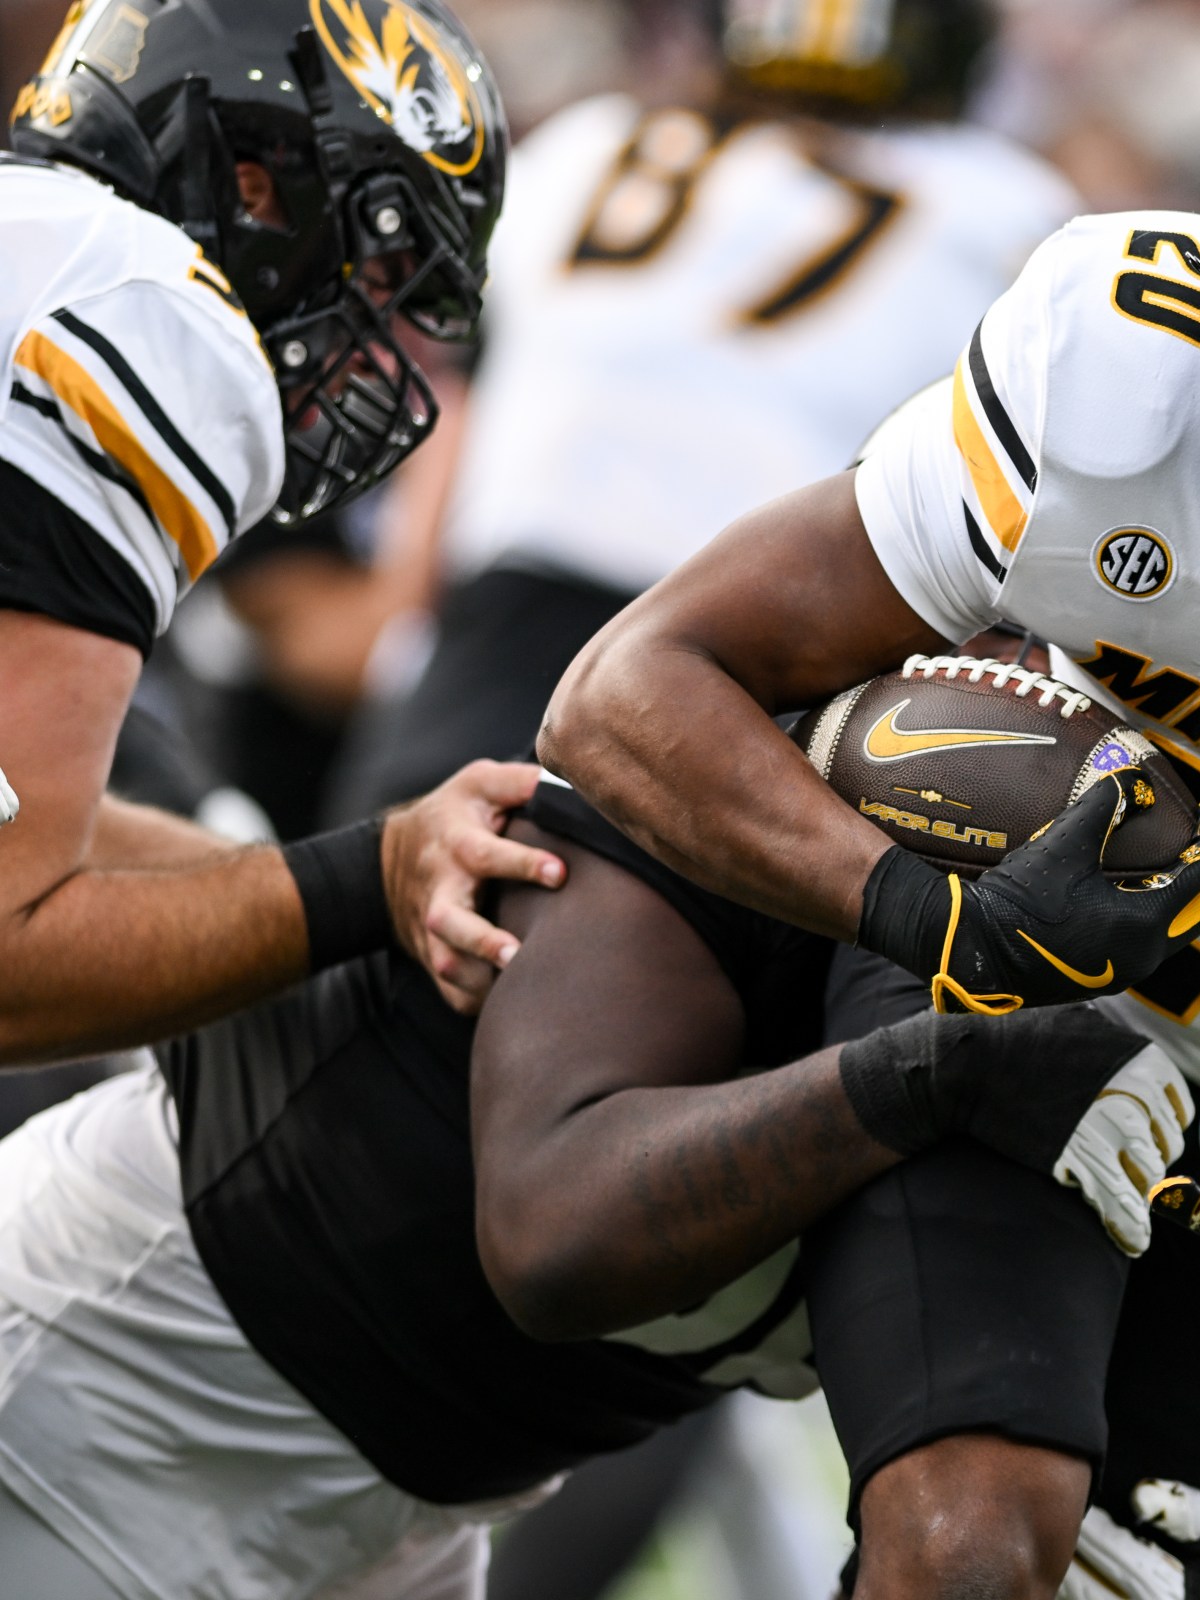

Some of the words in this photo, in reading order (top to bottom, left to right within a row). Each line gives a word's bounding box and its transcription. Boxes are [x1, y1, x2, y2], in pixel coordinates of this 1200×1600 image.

[1101, 535, 1165, 594] SEC
[859, 797, 932, 834] VAPOR
[931, 820, 1008, 849] ELITE
